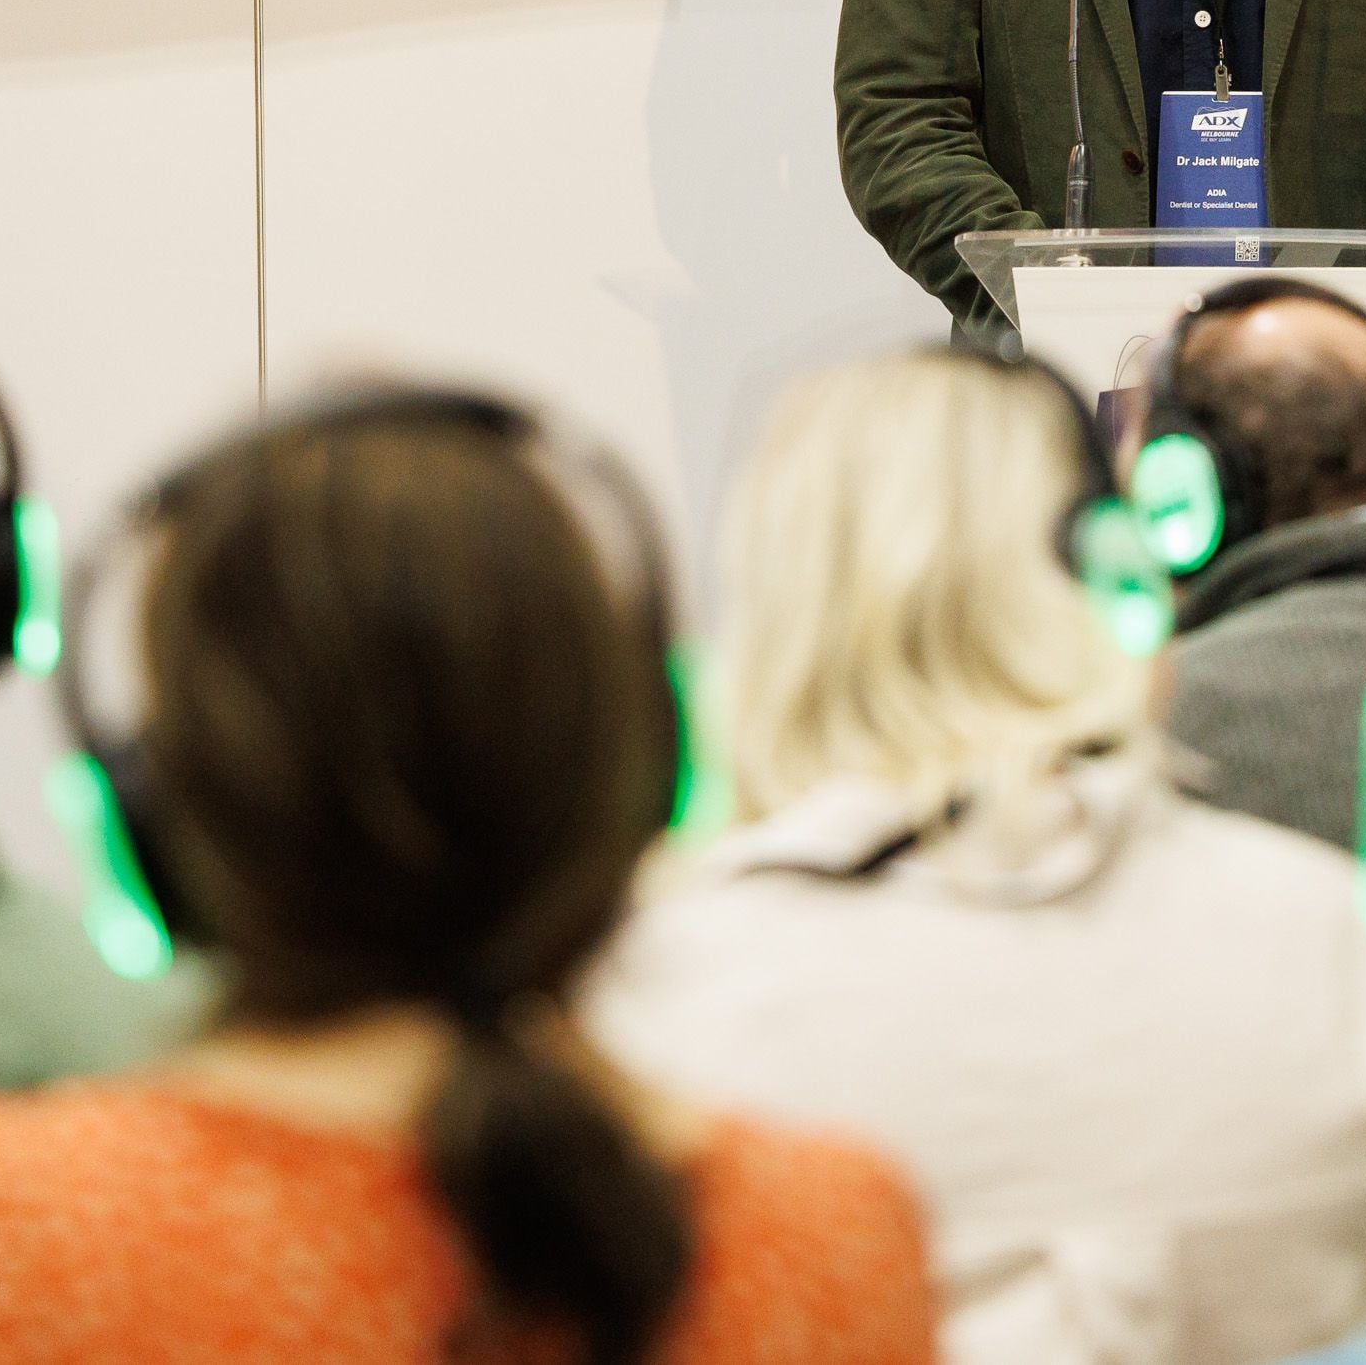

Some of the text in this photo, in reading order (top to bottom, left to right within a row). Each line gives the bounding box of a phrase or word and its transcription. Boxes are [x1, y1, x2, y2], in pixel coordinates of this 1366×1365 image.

[1199, 116, 1242, 129] ADX
[1177, 156, 1260, 169] Dr Jack Milgate
[1202, 201, 1234, 210] Specialist
[1235, 201, 1258, 209] Dentist
